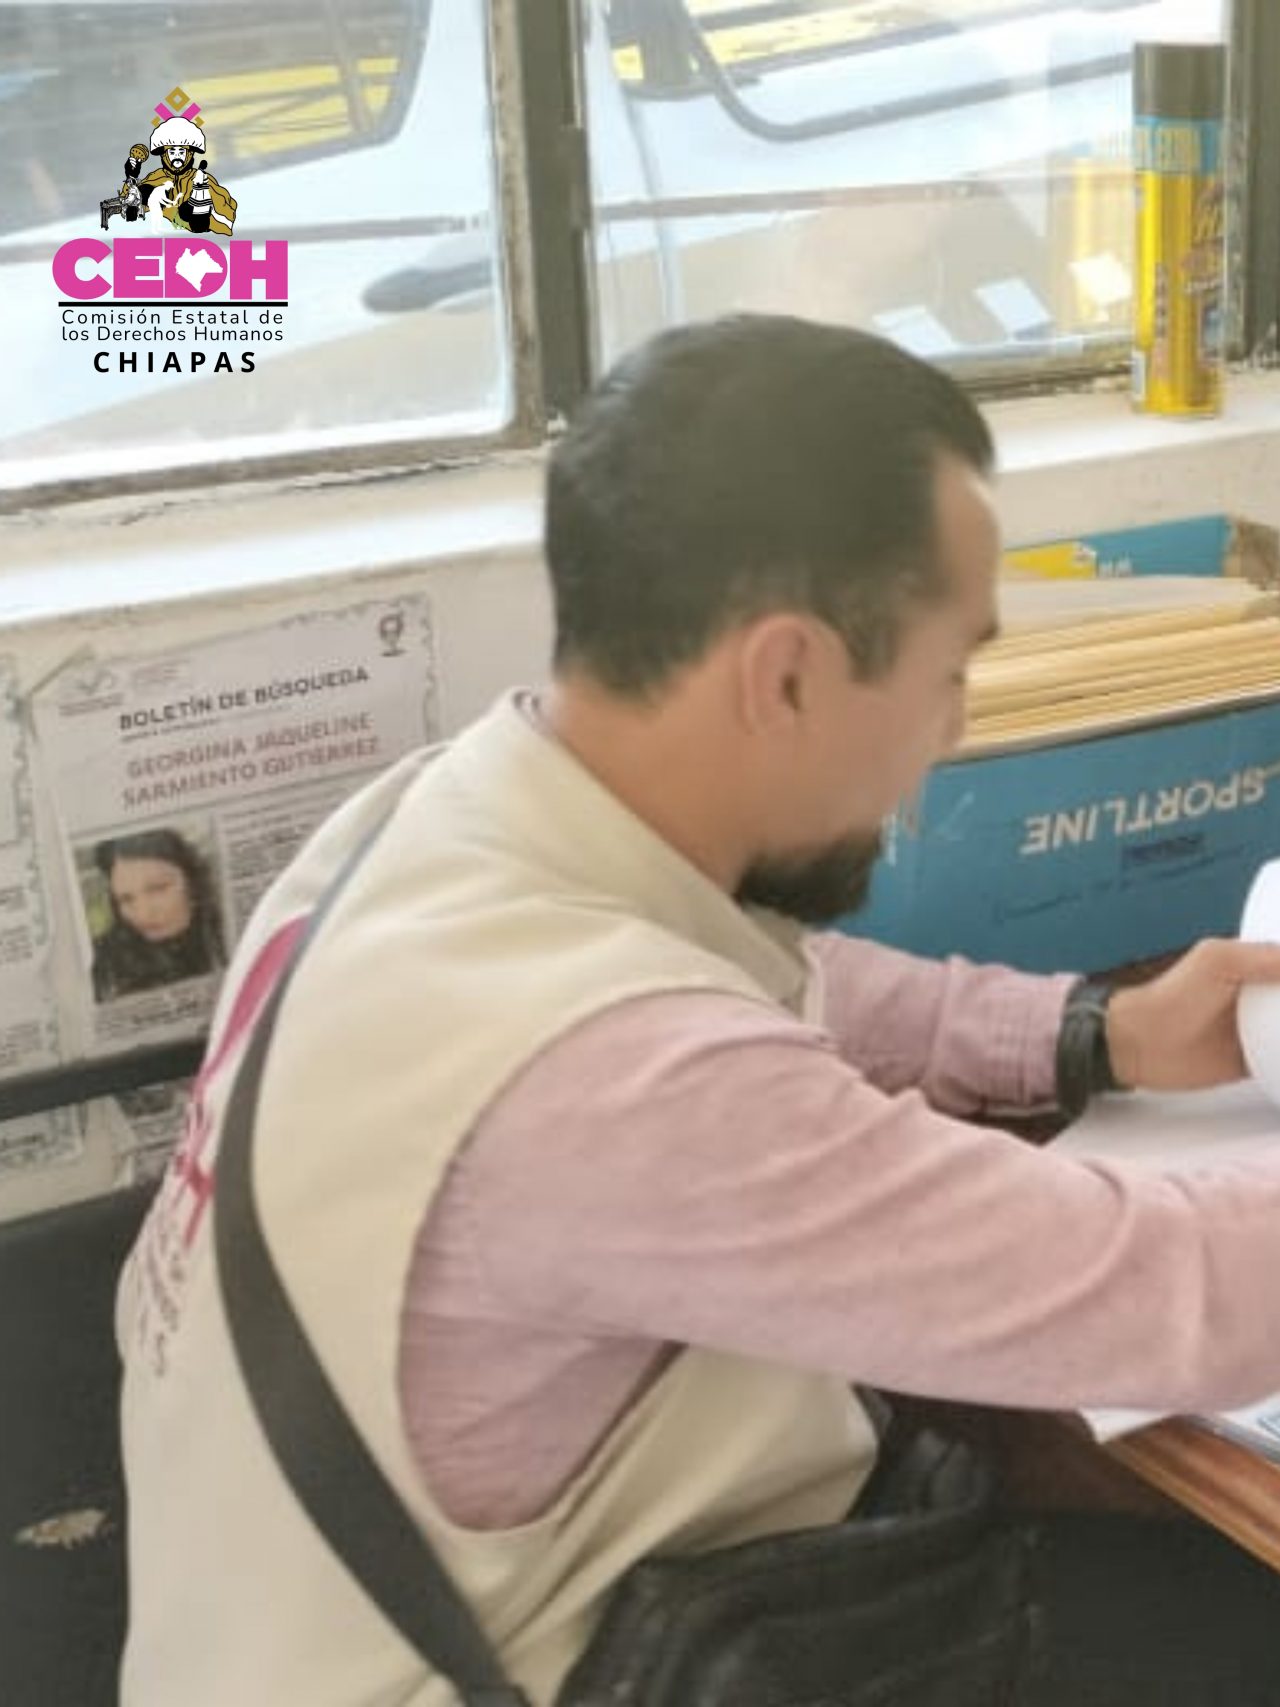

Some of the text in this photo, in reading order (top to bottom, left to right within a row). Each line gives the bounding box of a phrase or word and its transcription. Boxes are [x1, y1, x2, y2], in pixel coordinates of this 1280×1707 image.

[120, 694, 212, 730] BOLETÍN
[217, 690, 248, 710] DE
[127, 738, 247, 779] GEORGINA
[123, 763, 256, 810] SARMIENTO
[1019, 767, 1266, 855] SPORTLINE
